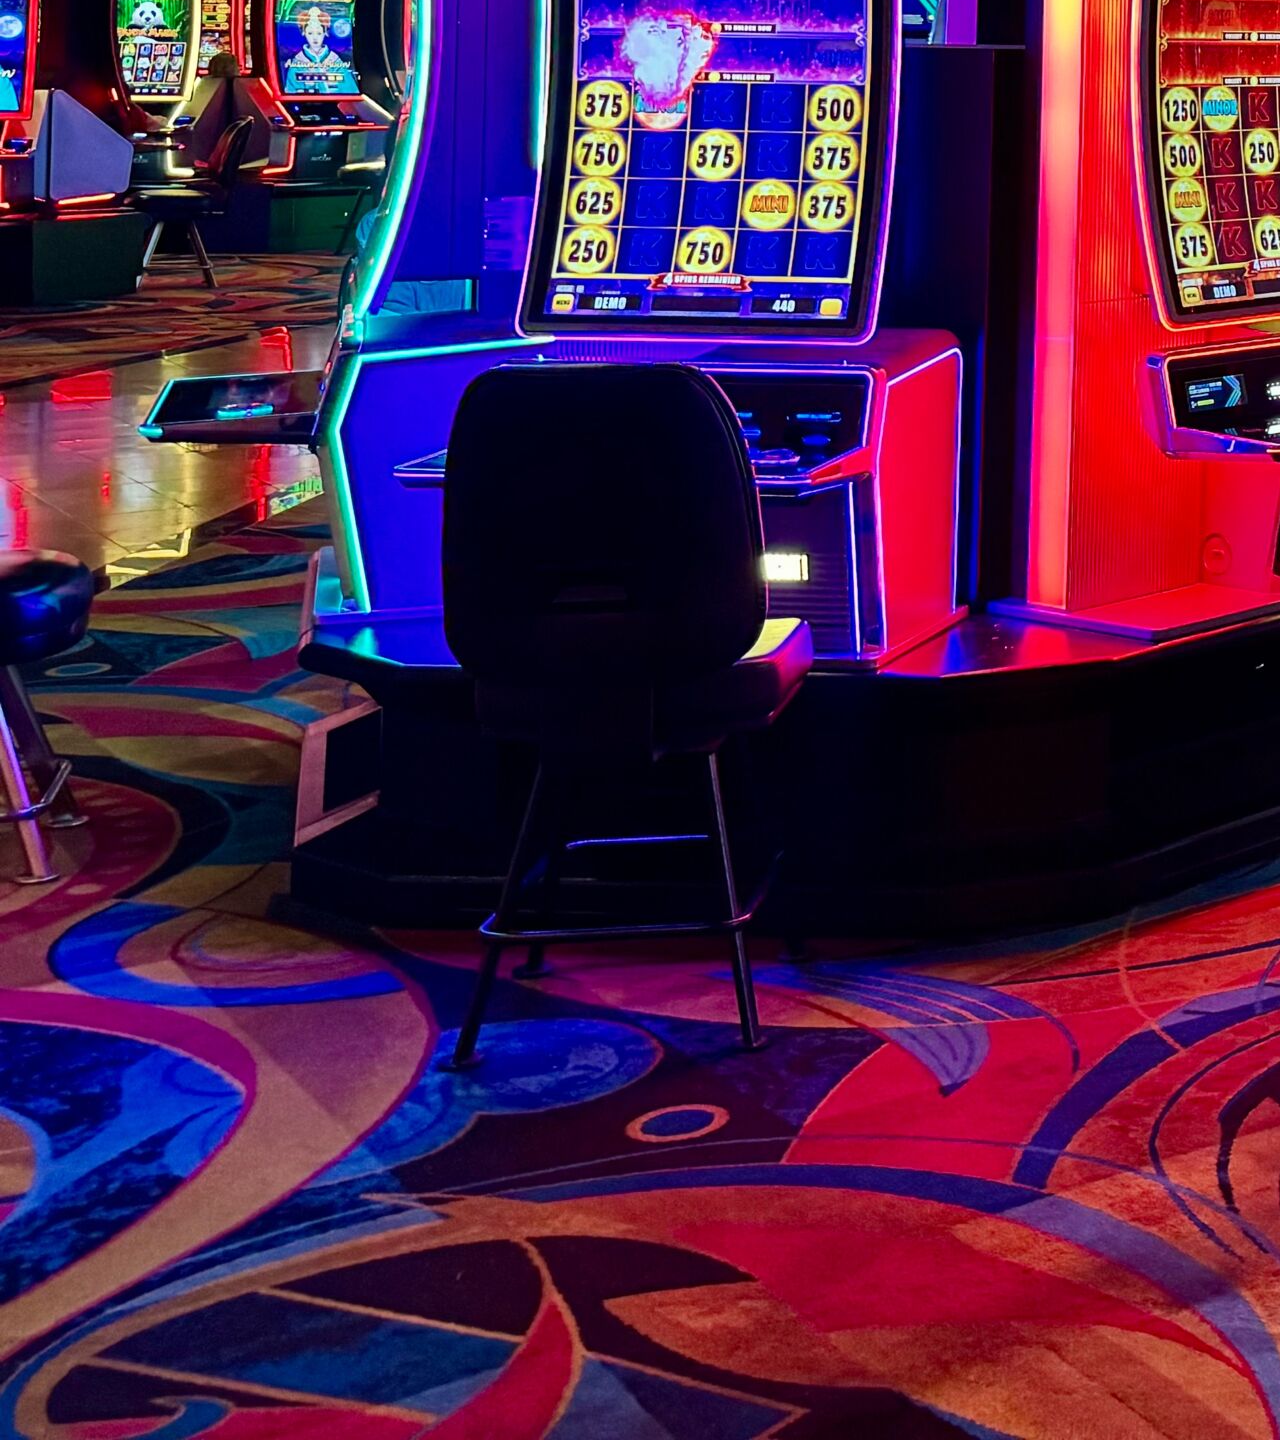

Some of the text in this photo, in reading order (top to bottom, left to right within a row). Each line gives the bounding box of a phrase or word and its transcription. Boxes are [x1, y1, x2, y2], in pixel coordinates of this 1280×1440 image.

[585, 95, 623, 117] 375
[816, 98, 855, 121] 500
[1164, 97, 1197, 122] 1250
[1248, 92, 1270, 123] K
[581, 142, 619, 166] 750
[696, 144, 734, 168] 375
[812, 146, 851, 170] 375
[1169, 144, 1197, 168] 500
[1249, 141, 1275, 164] 250
[575, 191, 614, 214] 625
[750, 194, 788, 213] MINI
[807, 196, 847, 219] 375
[568, 240, 609, 263] 250
[686, 241, 724, 265] 750
[1180, 235, 1207, 259] 375
[594, 297, 627, 309] DEMO
[1213, 285, 1237, 299] DEMO
